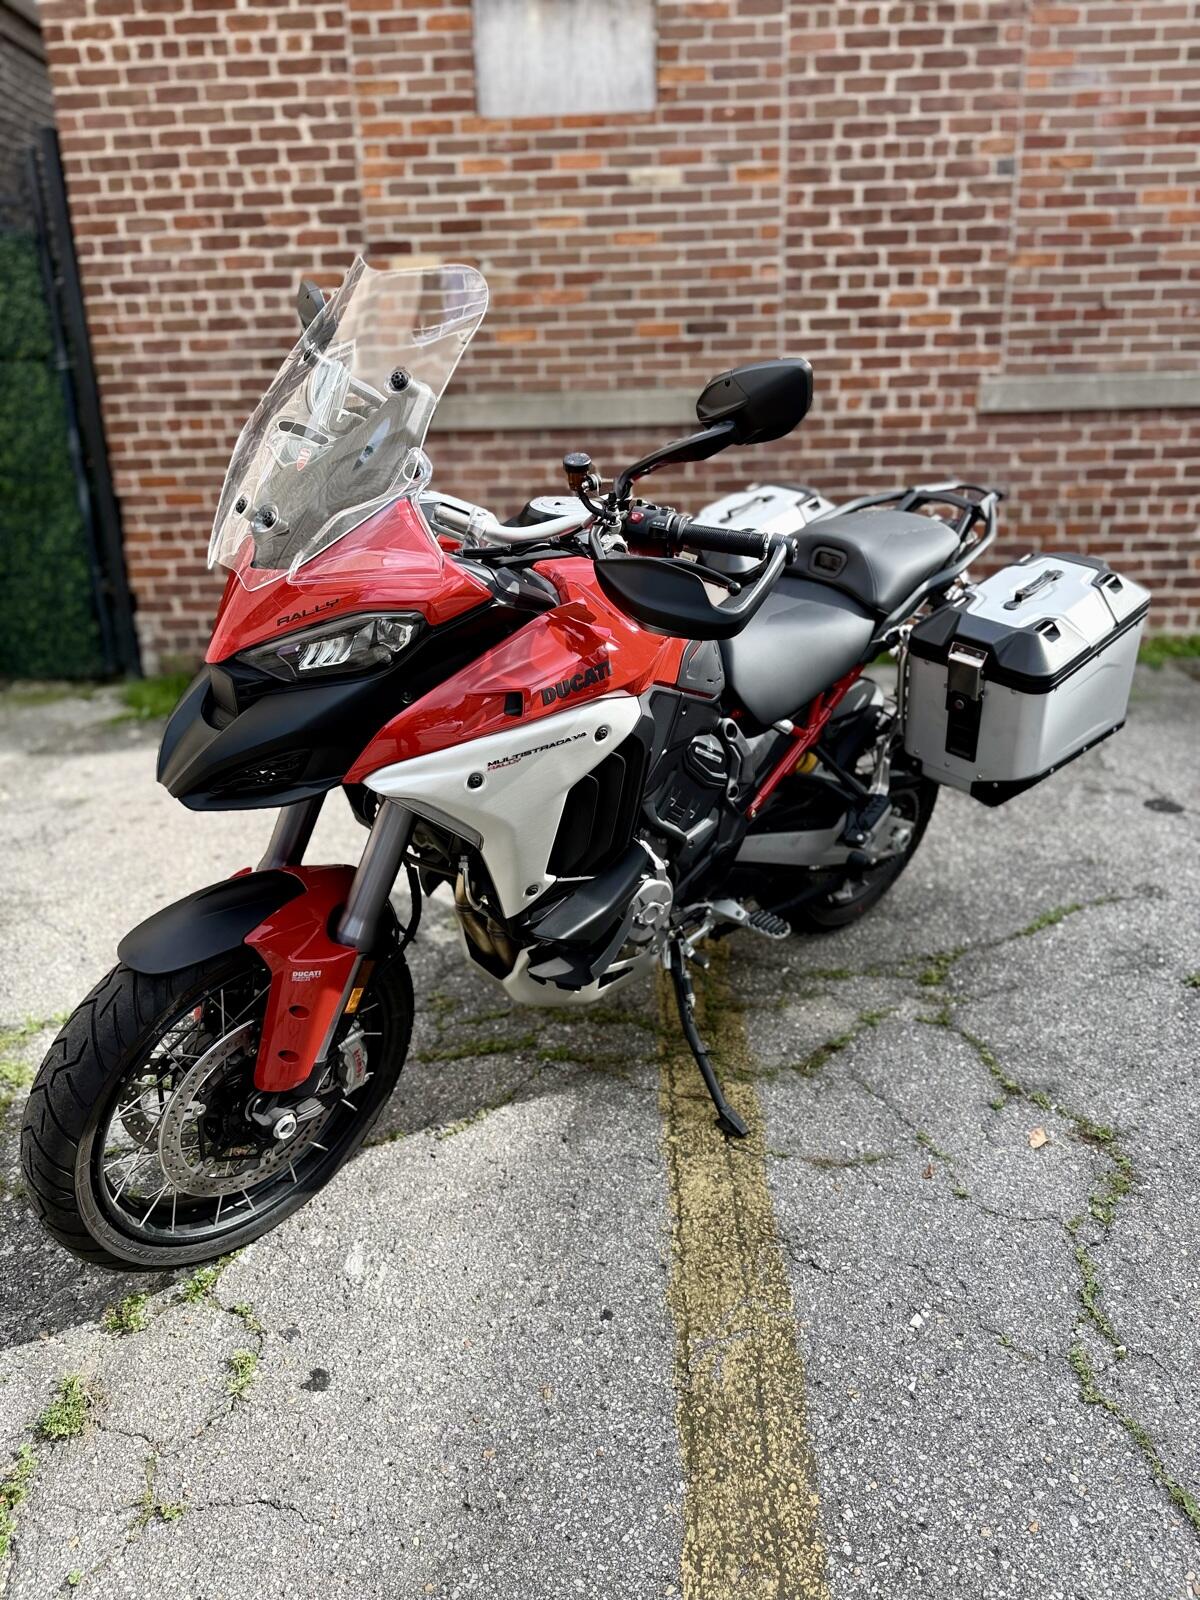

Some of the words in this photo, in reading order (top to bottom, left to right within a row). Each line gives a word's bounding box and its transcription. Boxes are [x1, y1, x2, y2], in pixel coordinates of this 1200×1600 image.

[276, 598, 340, 627] RALLY
[541, 660, 611, 706] DUCATI
[487, 737, 573, 767] MULTISTRADA
[292, 969, 322, 977] DUCATI
